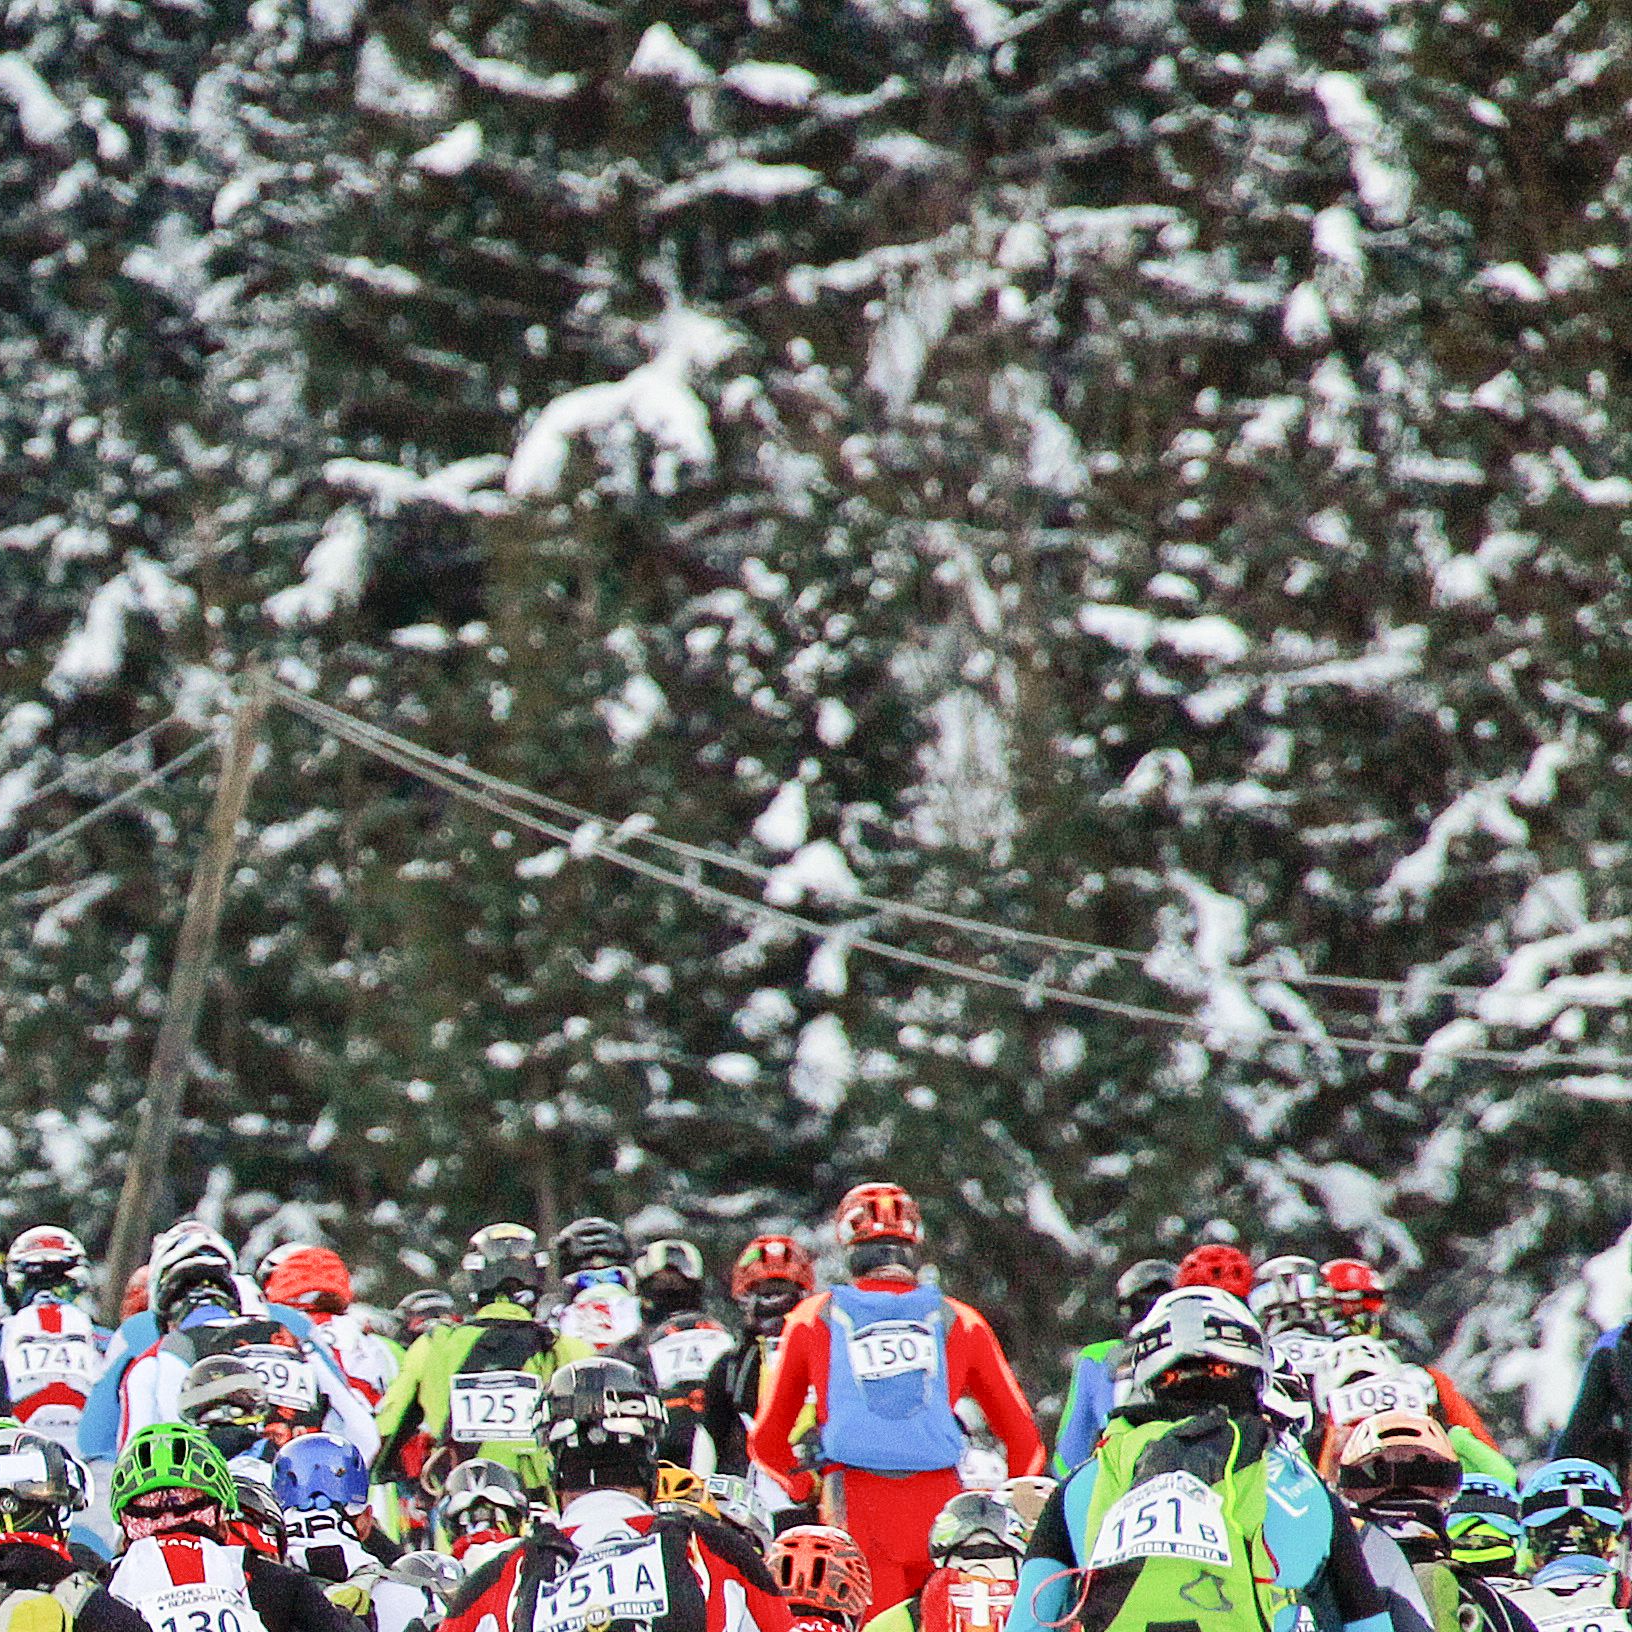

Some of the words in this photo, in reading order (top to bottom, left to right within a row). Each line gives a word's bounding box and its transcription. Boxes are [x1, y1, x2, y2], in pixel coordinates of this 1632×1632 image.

[22, 1346, 71, 1369] 174
[861, 1338, 917, 1366] 150
[462, 1394, 516, 1424] 125
[1342, 1385, 1397, 1411] 108
[1111, 1497, 1182, 1550] 151
[1198, 1523, 1218, 1545] B
[548, 1564, 615, 1616] 151
[635, 1564, 655, 1593] A
